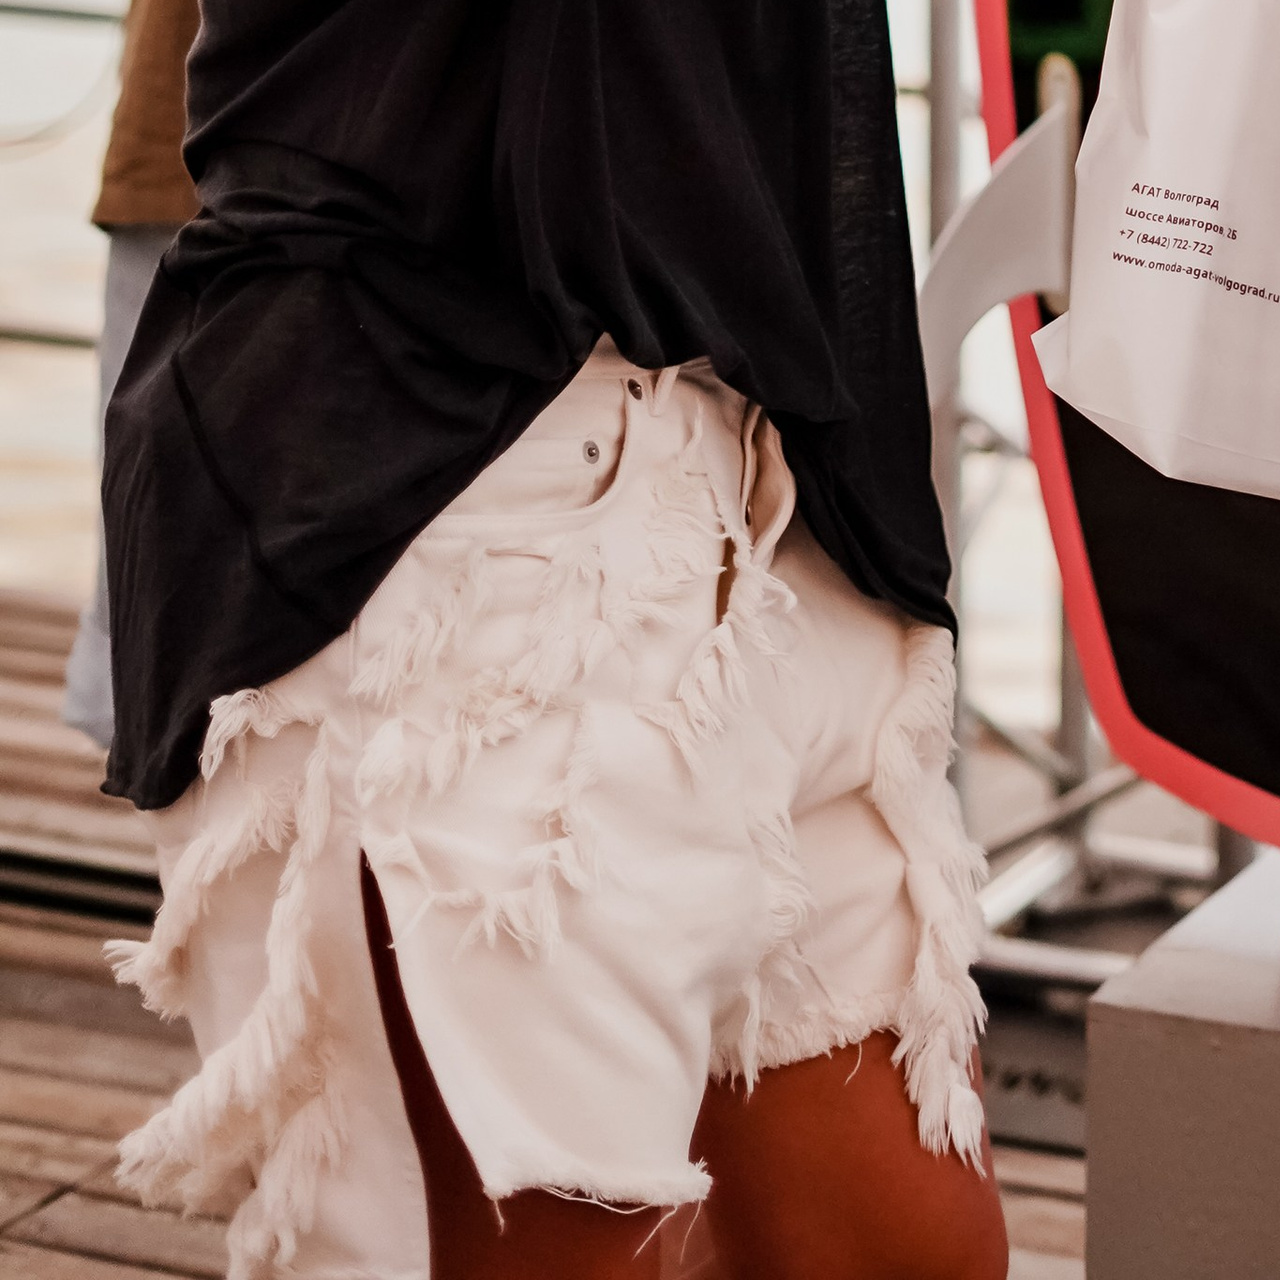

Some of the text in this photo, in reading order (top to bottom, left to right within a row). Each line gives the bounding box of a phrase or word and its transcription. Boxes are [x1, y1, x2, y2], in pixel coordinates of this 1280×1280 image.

[1131, 182, 1220, 211] АГАТ Волгоград
[1125, 206, 1164, 223] шоссе
[1119, 229, 1214, 256] +7 (8442) 722-722
[1112, 251, 1280, 303] www.omoda-agat-volgograd.ru
